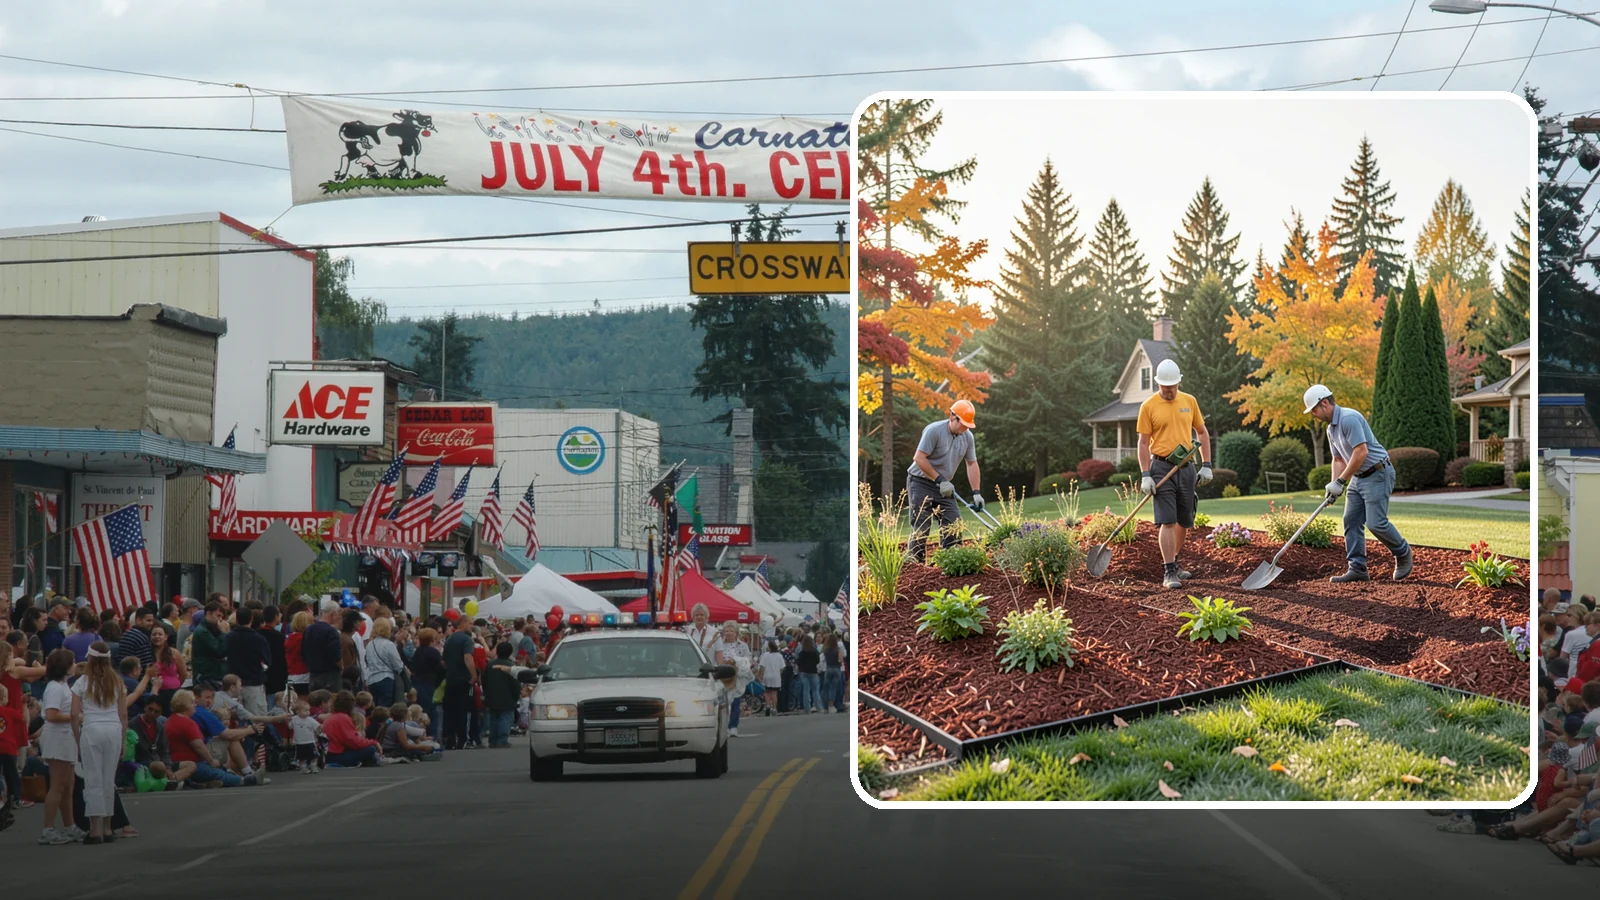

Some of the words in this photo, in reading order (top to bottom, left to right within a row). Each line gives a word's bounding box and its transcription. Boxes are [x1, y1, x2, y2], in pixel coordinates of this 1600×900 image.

[481, 141, 605, 193] JULY
[632, 150, 746, 197] 4th.
[697, 254, 850, 280] CROSSWA
[282, 380, 373, 420] ACE
[406, 409, 452, 422] CEDAR
[283, 421, 370, 436] Hardware
[416, 428, 477, 447] Coca-Cola
[354, 466, 386, 480] Simpl
[83, 485, 94, 494] St.
[95, 485, 124, 494] Vincent
[126, 486, 136, 495] de
[137, 486, 155, 495] Paul
[212, 516, 330, 535] HARDARE
[688, 526, 742, 535] CRNATION
[699, 535, 730, 543] GLASS
